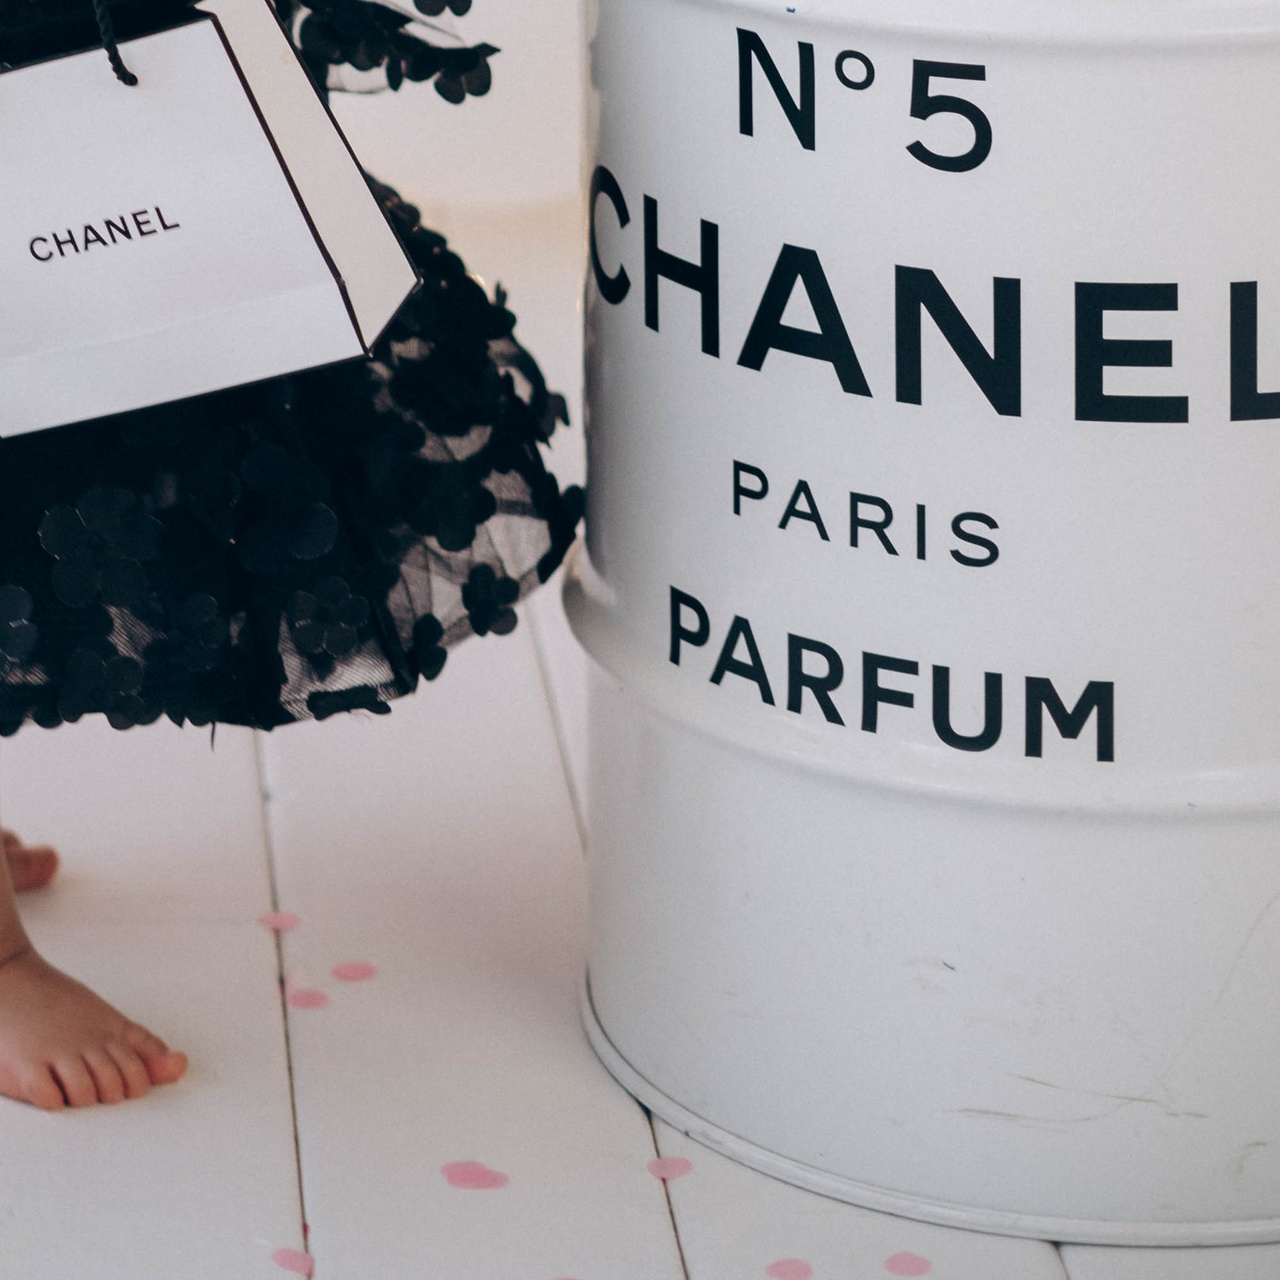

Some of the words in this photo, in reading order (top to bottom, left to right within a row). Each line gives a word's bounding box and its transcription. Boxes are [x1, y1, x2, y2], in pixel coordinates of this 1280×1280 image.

[29, 206, 181, 262] CHANEL
[732, 459, 1000, 568] PARIS
[669, 585, 1115, 763] PARFUM
